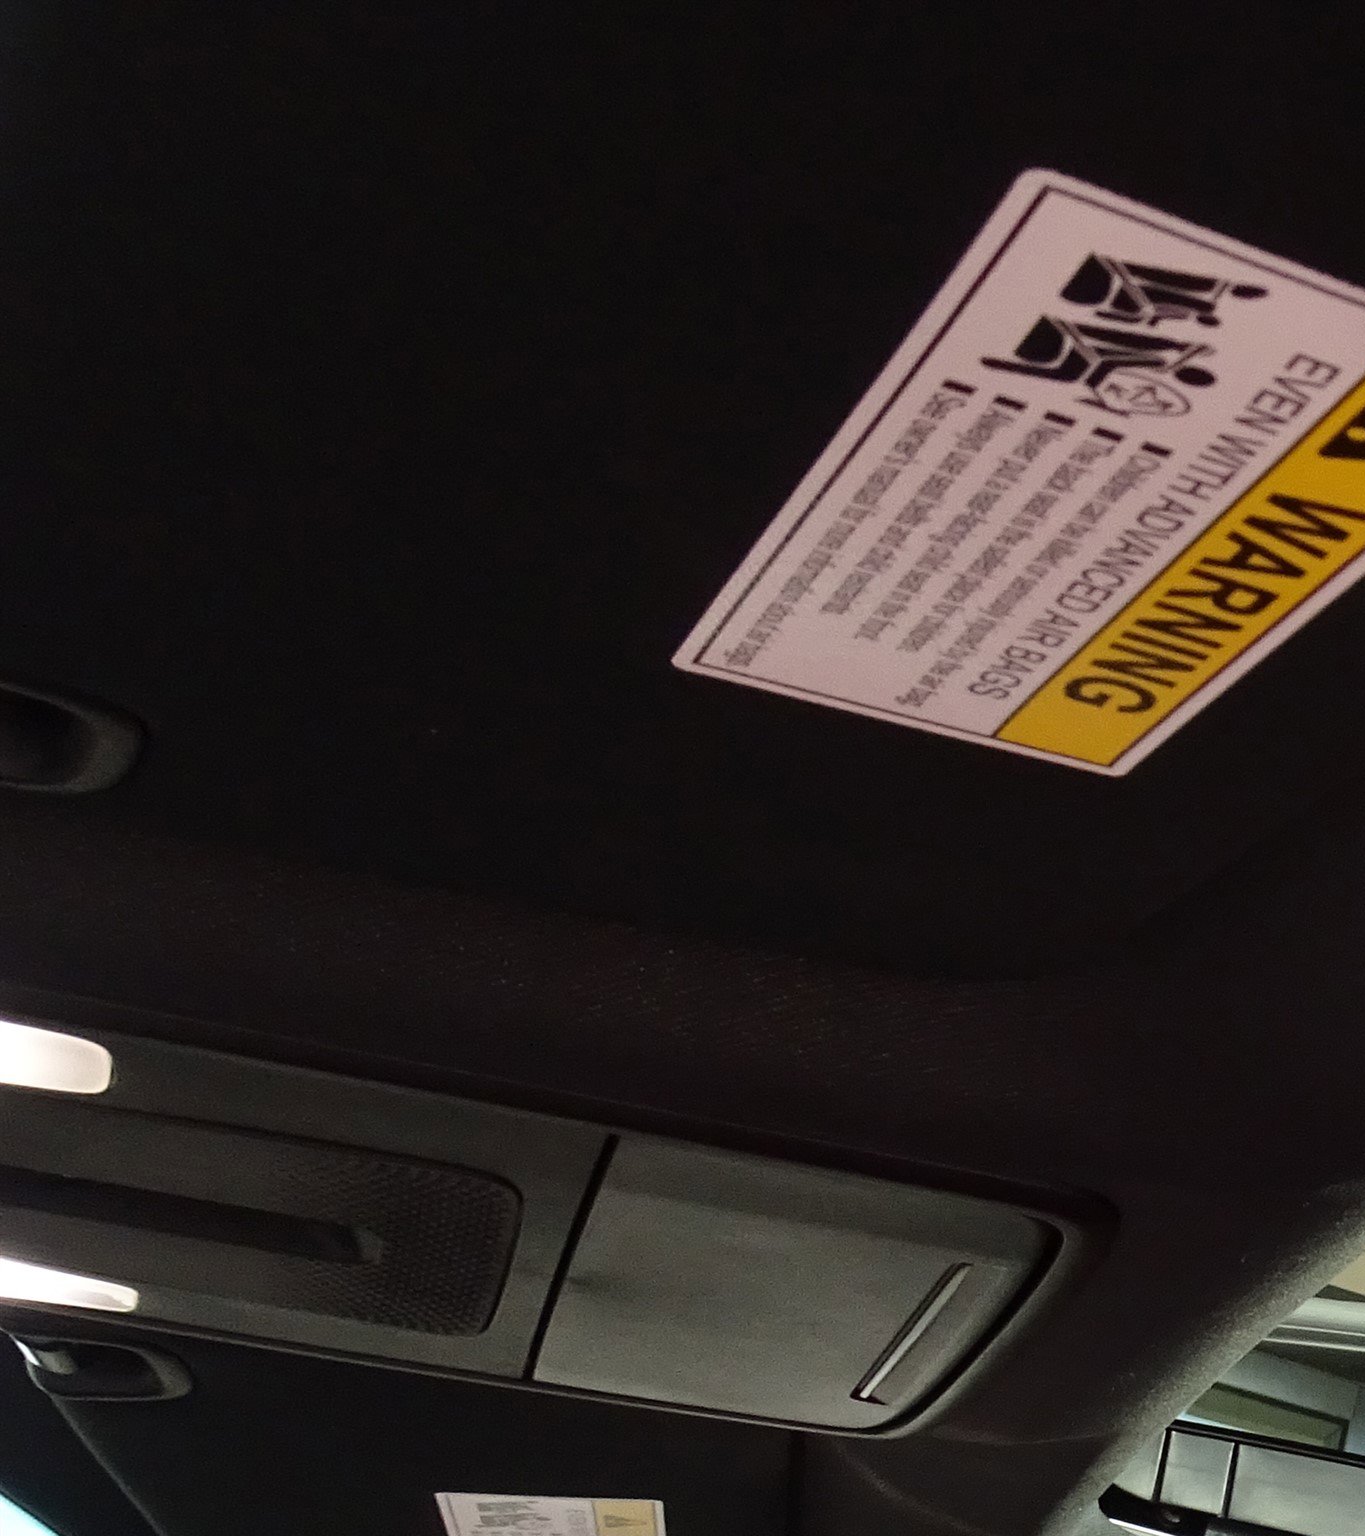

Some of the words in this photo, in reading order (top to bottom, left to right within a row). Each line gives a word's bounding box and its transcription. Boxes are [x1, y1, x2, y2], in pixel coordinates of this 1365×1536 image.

[1229, 351, 1344, 436] EVEN
[1165, 428, 1267, 501] WITH
[1051, 493, 1202, 614] ADVANCED
[1016, 609, 1085, 649] AIR
[964, 644, 1050, 701] BAGS
